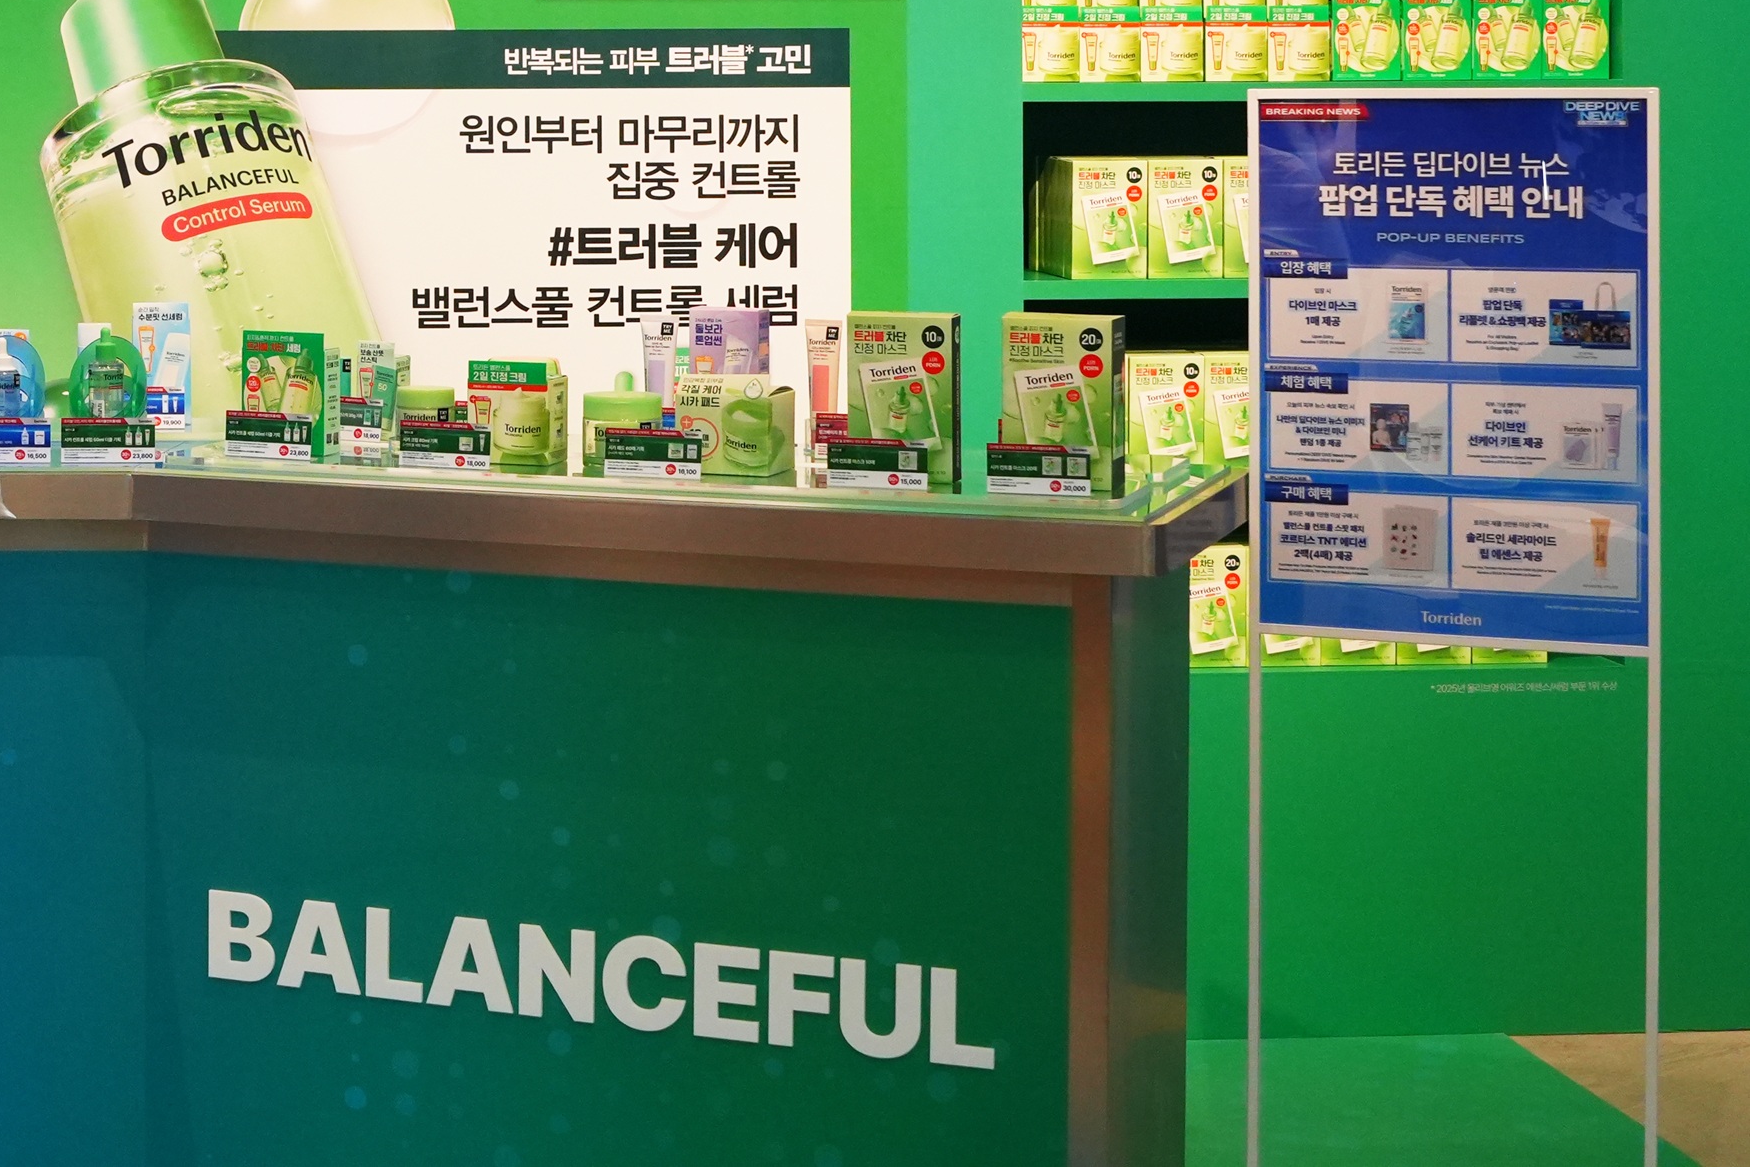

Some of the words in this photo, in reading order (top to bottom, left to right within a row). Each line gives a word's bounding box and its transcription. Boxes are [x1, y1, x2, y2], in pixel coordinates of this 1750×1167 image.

[502, 44, 603, 76] 반복되는
[609, 45, 659, 75] 피부
[756, 44, 812, 75] 고민
[1265, 107, 1323, 115] BREAKING
[1326, 107, 1361, 115] NEWS
[1564, 101, 1604, 111] DEEP
[1604, 101, 1640, 111] DIVE
[457, 114, 602, 154] 원인부터
[617, 114, 800, 154] 마무리까지
[101, 108, 313, 188] Torriden
[1332, 150, 1406, 177] 토리든
[1412, 150, 1513, 178] 딥다이브
[1517, 152, 1569, 178] 뉴스
[160, 166, 299, 205] BALANCEFUL
[605, 158, 679, 199] 집중
[692, 158, 801, 199] 컨트롤
[1089, 195, 1123, 206] Torriden
[1318, 182, 1378, 215] 팝업
[1385, 182, 1446, 216] 단독
[1452, 183, 1514, 217] 혜택
[1521, 184, 1583, 218] 안내
[172, 200, 246, 233] Control
[249, 197, 306, 215] Serum
[547, 219, 702, 268] #트러블
[714, 219, 798, 267] 케어
[1376, 232, 1440, 242] POP-UP
[1444, 233, 1524, 243] BENEFITS
[1279, 260, 1304, 274] 입장
[1306, 261, 1332, 275] 혜택
[411, 283, 573, 328] 밸런스풀
[1288, 300, 1327, 311] 다이브인
[1327, 301, 1357, 311] 마스크
[1482, 299, 1501, 310] 팝업
[1501, 300, 1522, 311] 단독
[1321, 316, 1341, 326] 제공
[853, 329, 884, 341] 트러블
[885, 330, 907, 342] 차단
[853, 343, 874, 354] 진정
[876, 343, 907, 355] 마스크
[472, 371, 488, 381] 2일
[490, 371, 508, 381] 진정
[508, 372, 526, 382] 크림
[868, 364, 916, 378] Torriden
[1024, 371, 1074, 385] Torriden
[1280, 374, 1305, 388] 체험
[1307, 375, 1332, 389] 혜택
[680, 383, 700, 394] 각질
[701, 383, 722, 395] 케어
[679, 395, 699, 407] 시카
[700, 395, 720, 407] 패드
[504, 423, 541, 433] Torriden
[26, 451, 47, 460] 16,500
[131, 451, 153, 460] 23,800
[1062, 484, 1086, 492] 30,000
[1280, 485, 1305, 499] 구매
[1307, 486, 1332, 500] 혜택
[1420, 610, 1482, 626] Torriden
[205, 887, 998, 1070] BALANCEFUL
